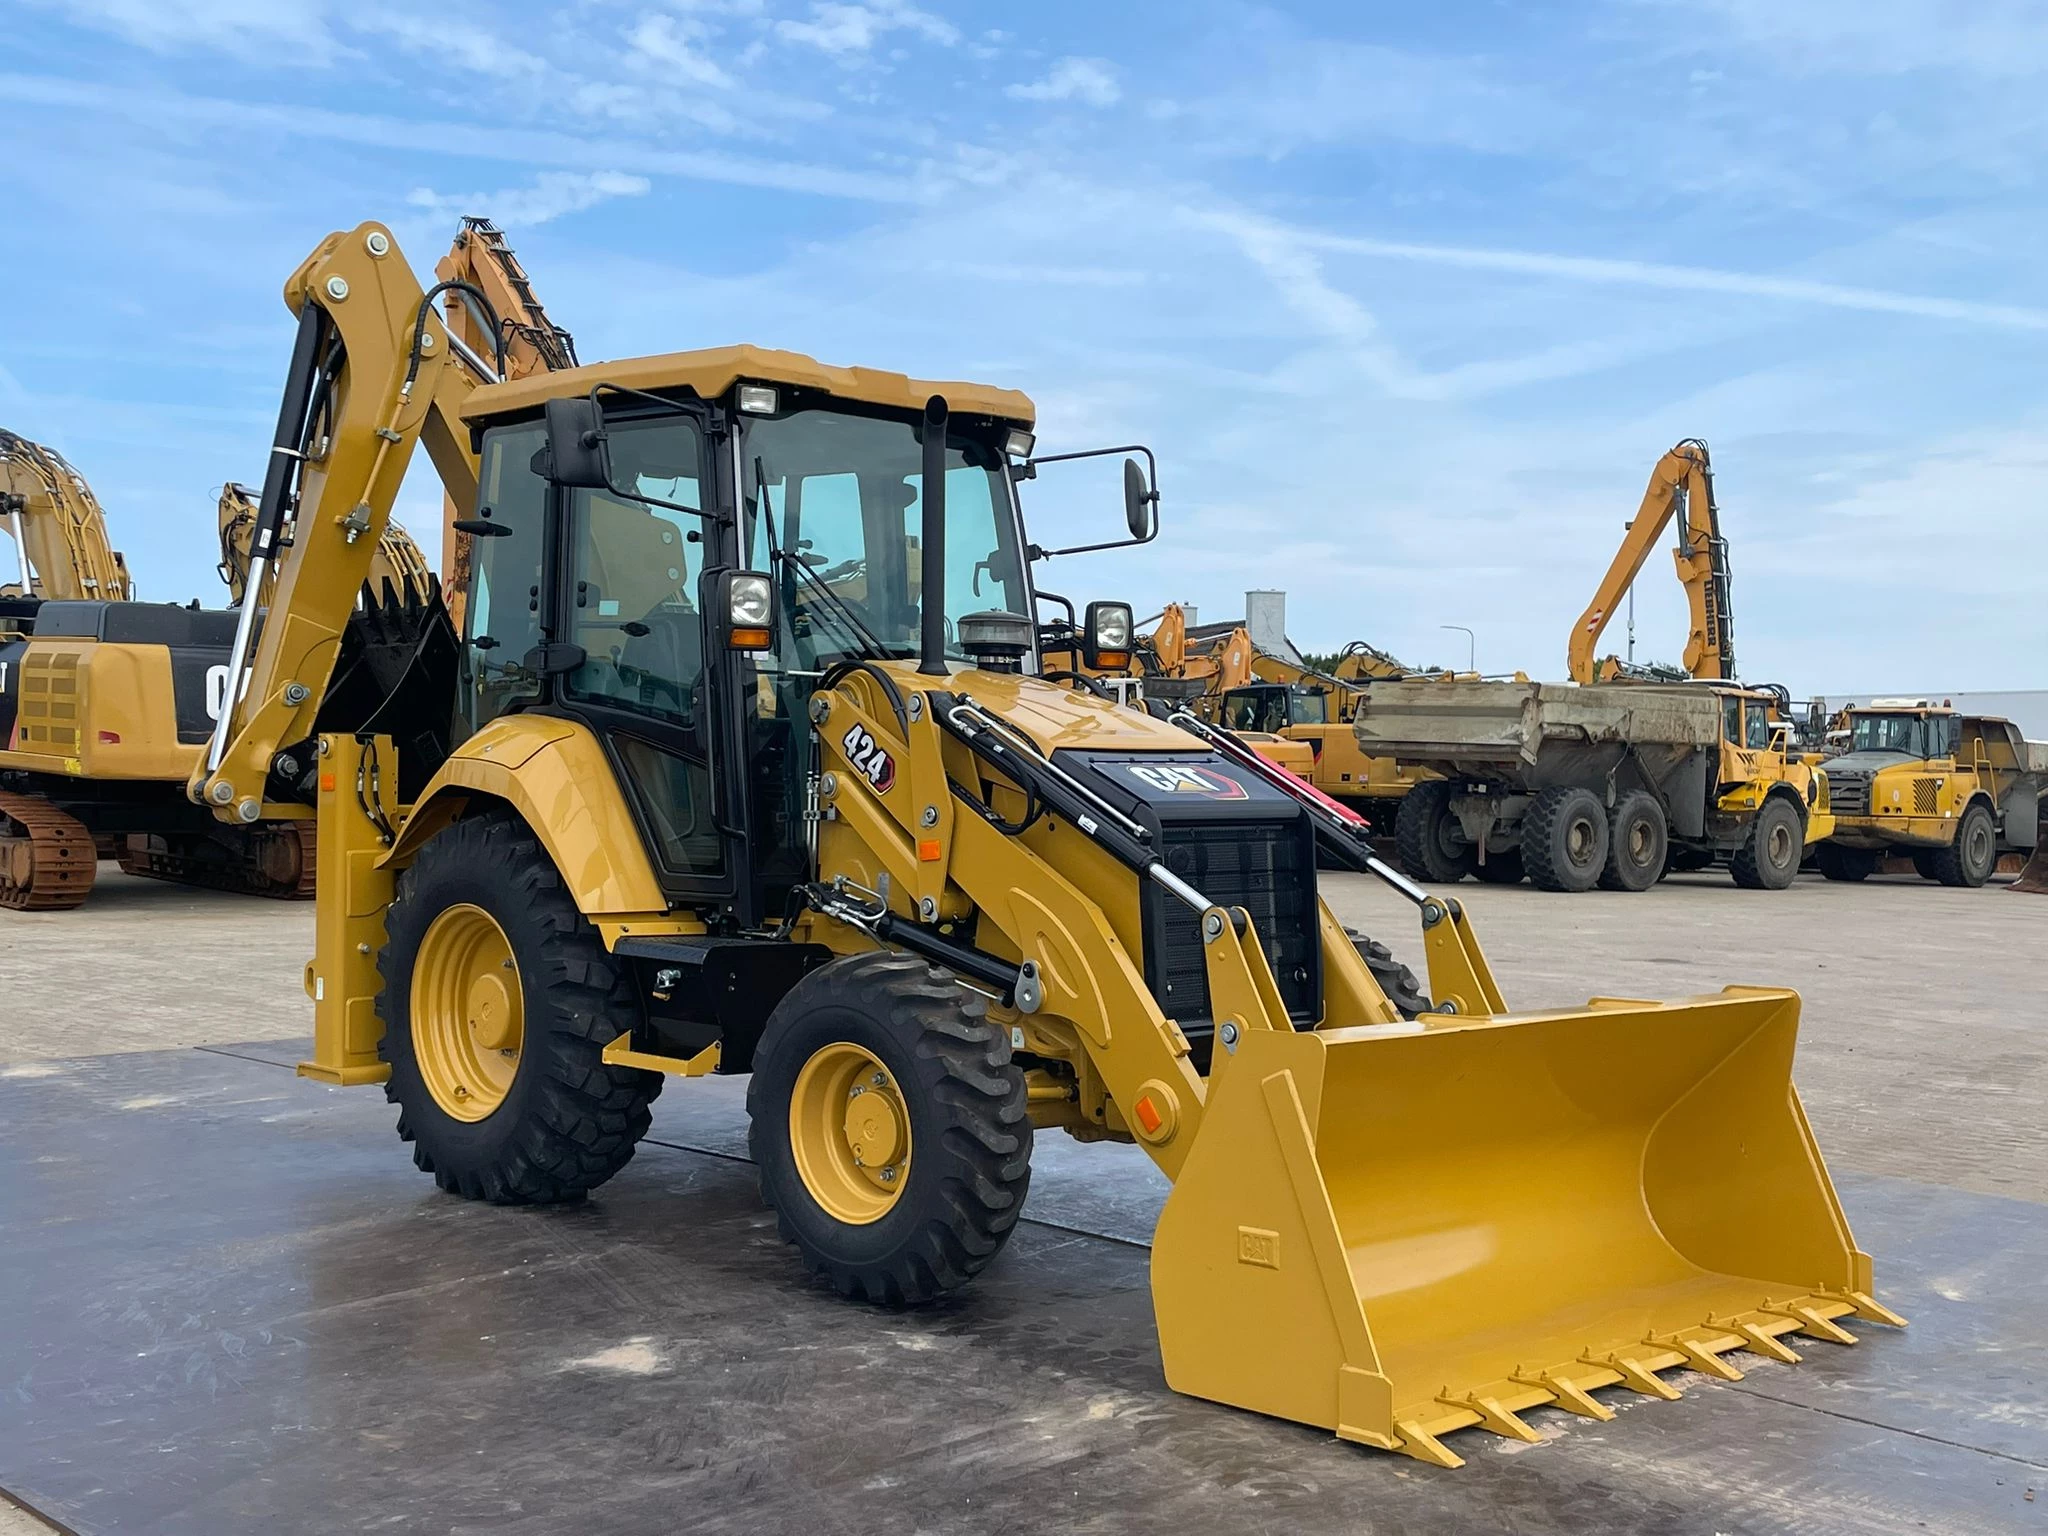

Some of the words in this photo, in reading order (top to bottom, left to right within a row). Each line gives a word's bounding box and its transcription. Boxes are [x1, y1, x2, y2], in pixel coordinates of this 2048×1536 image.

[1704, 580, 1717, 647] LIEBHERR
[843, 724, 887, 784] 424
[1128, 766, 1221, 792] CAT
